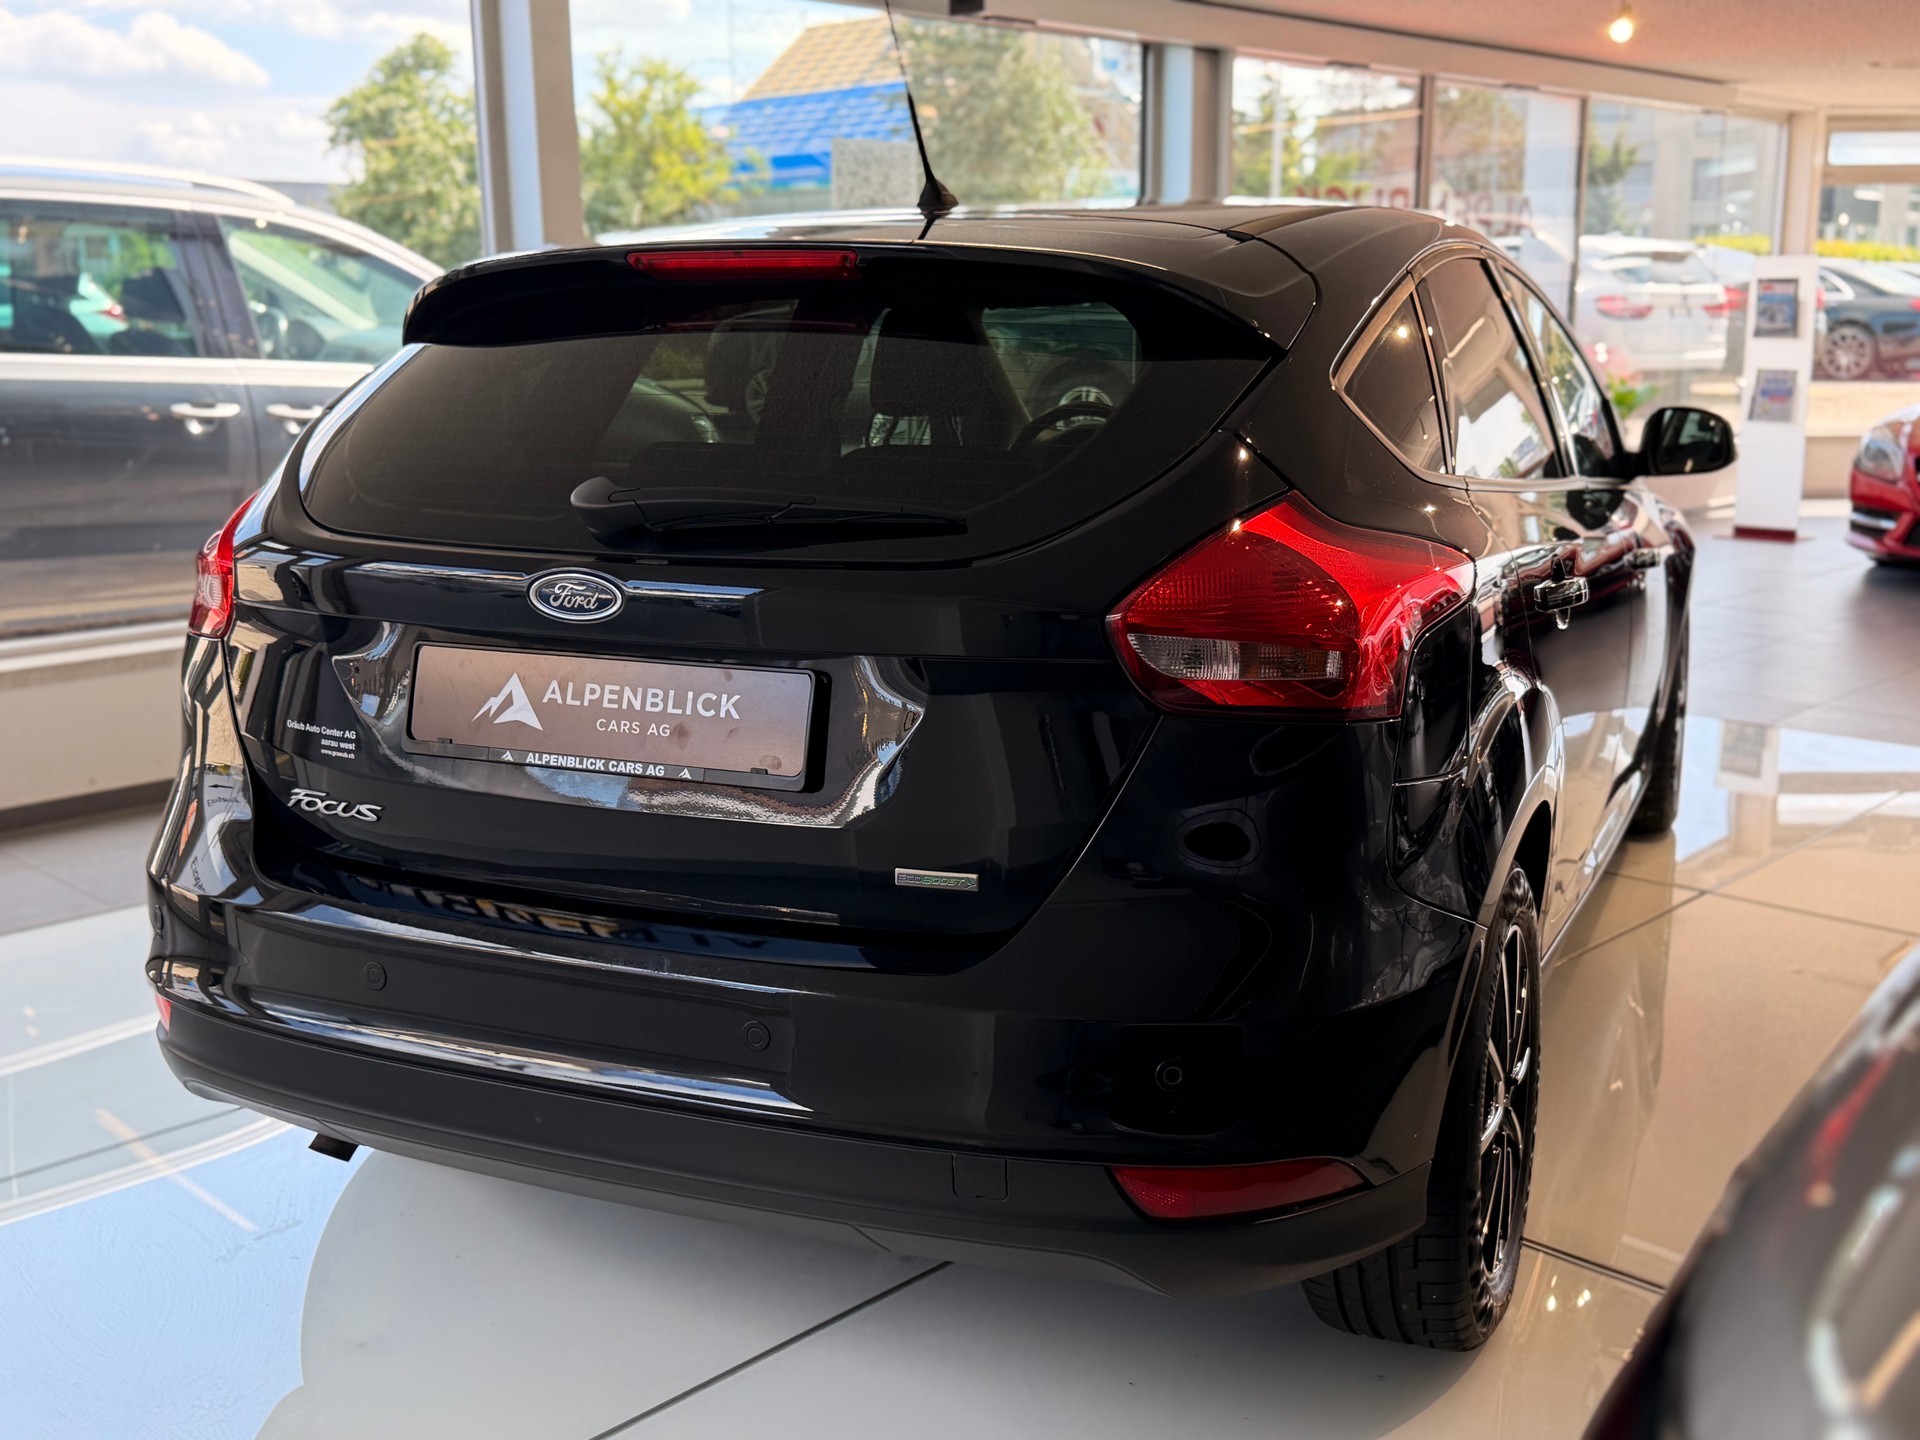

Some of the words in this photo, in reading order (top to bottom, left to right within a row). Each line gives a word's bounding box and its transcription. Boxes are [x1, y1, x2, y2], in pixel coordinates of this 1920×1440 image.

[550, 583, 599, 610] Ford
[542, 680, 742, 720] ALPENBLICK
[305, 723, 320, 734] Auto
[321, 726, 343, 737] Center
[344, 730, 356, 739] AG
[596, 718, 640, 734] CARS
[647, 722, 671, 737] AG
[339, 742, 356, 750] west
[526, 752, 604, 770] ALPENBLICK
[609, 760, 643, 775] CARS
[647, 763, 665, 776] AG
